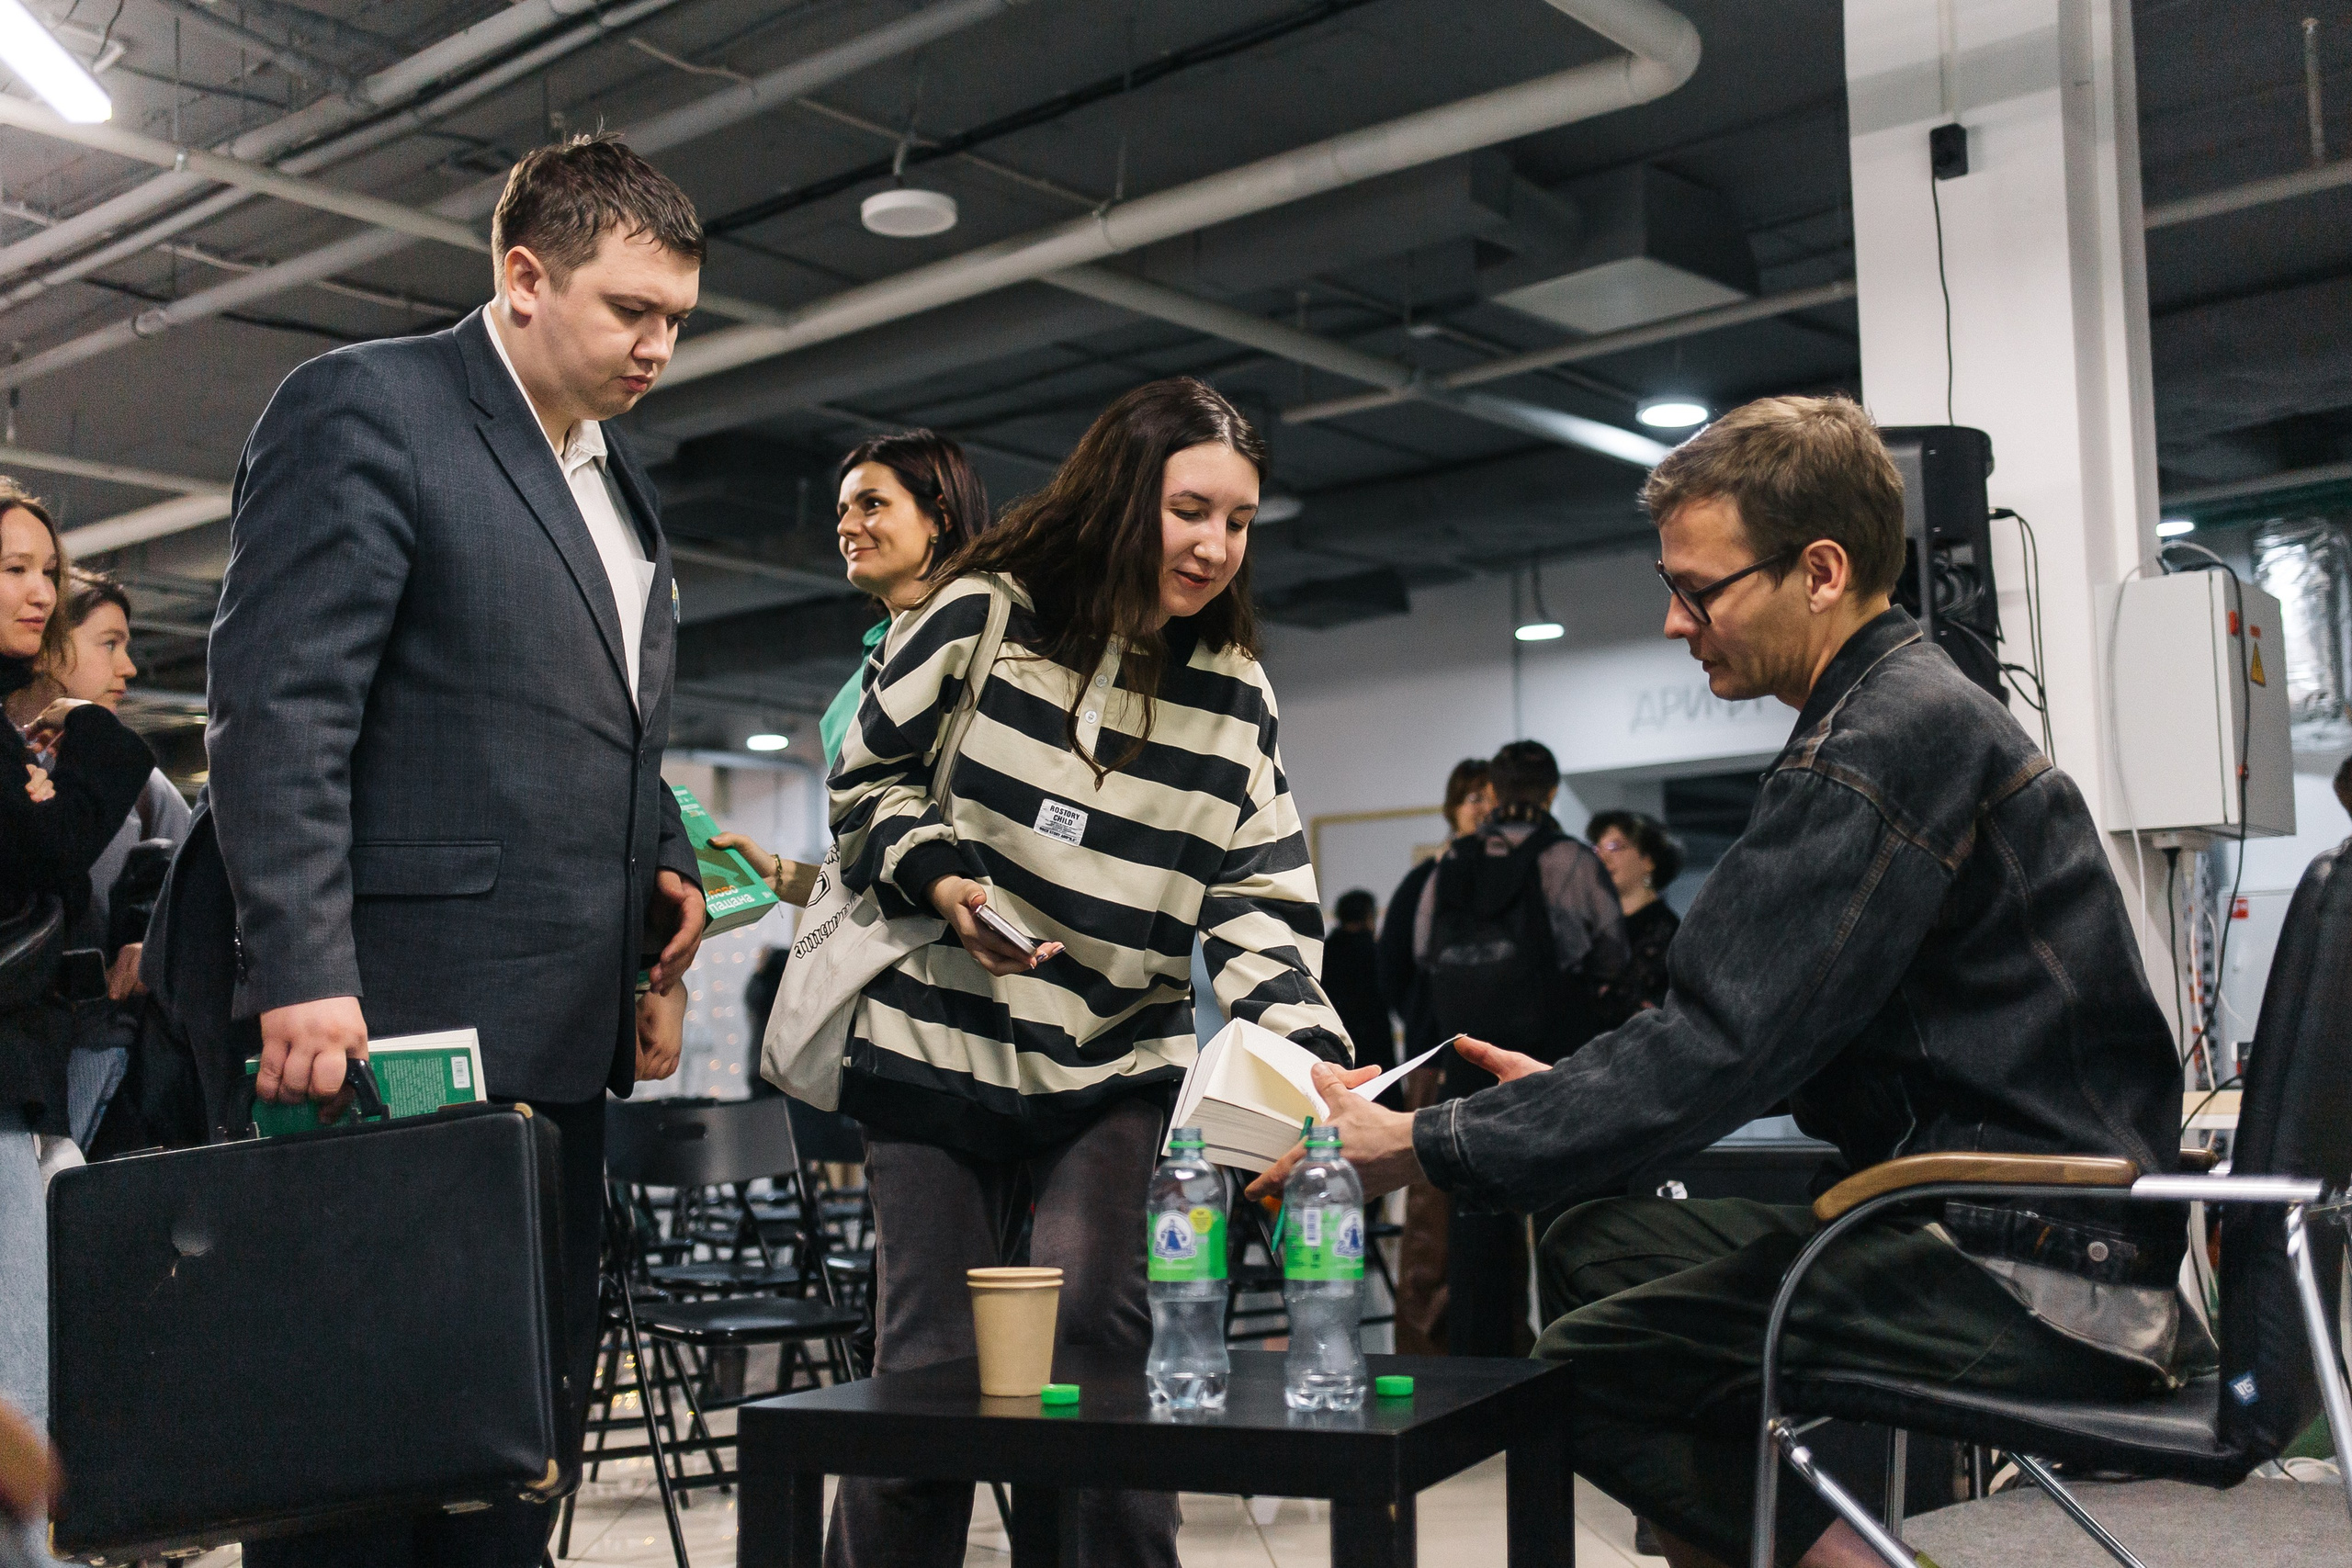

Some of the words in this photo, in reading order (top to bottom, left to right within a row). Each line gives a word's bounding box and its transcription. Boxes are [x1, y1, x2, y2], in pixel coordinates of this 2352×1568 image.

[1049, 805, 1080, 820] ROSTORY
[1053, 814, 1073, 827] CHILD
[706, 885, 739, 902] лово
